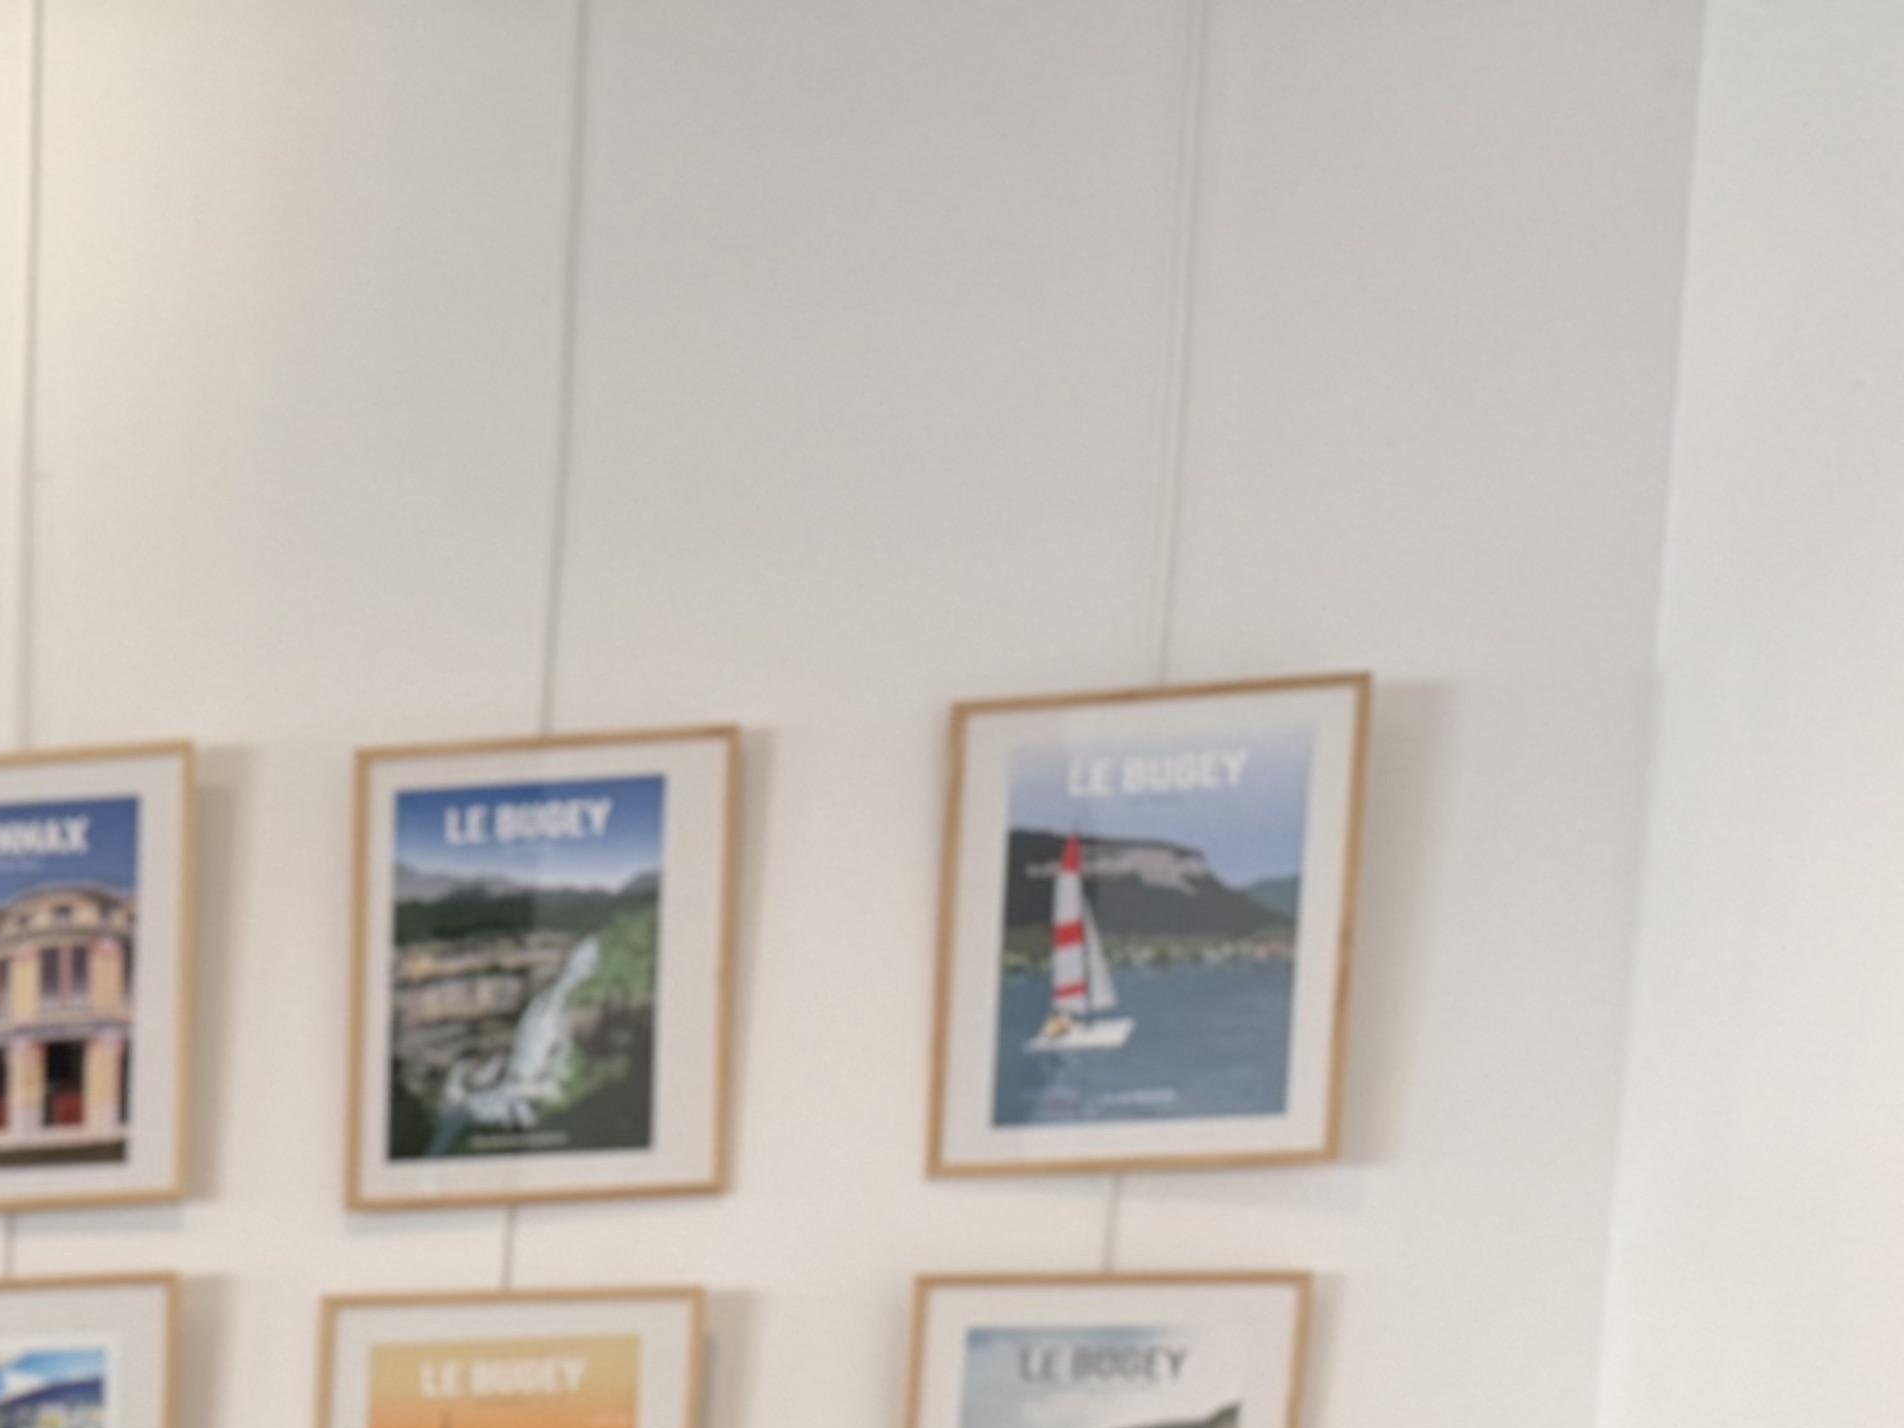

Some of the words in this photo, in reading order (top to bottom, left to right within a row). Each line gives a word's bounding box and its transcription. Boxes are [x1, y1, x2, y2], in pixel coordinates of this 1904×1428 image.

[1066, 756, 1113, 799] LE
[1121, 750, 1249, 796] BUGEY
[445, 804, 490, 846] LE
[495, 797, 614, 843] BUGEY
